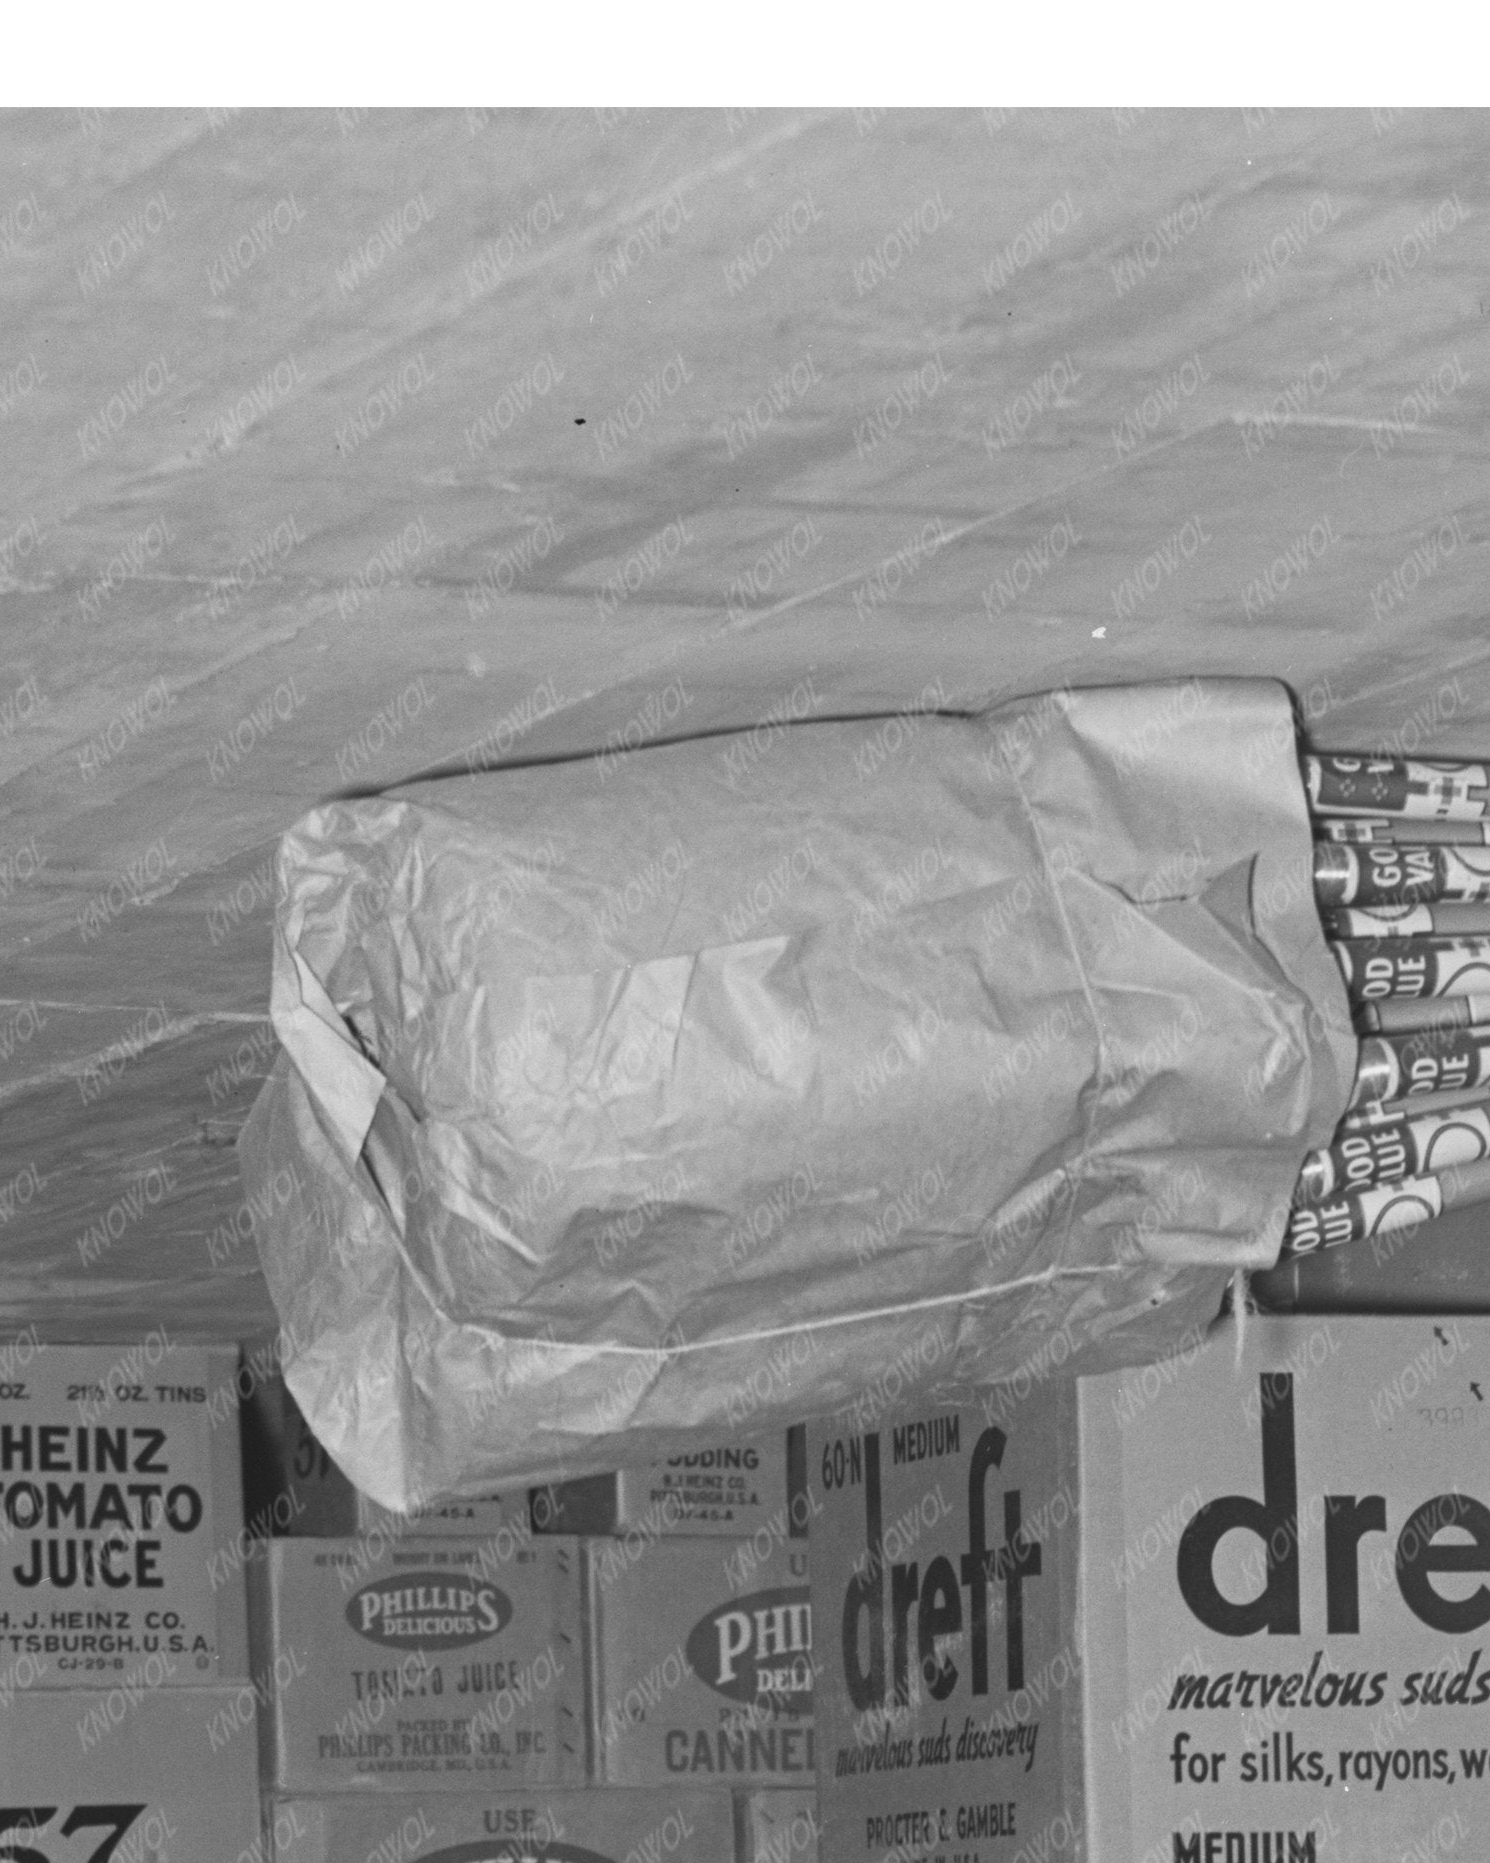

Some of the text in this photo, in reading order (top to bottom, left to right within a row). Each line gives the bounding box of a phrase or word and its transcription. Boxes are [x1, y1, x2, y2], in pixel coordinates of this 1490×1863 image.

[1, 1425, 168, 1473] HEINZ
[893, 1415, 960, 1464] MEDIUM
[13, 1539, 163, 1588] JUICE
[841, 1429, 1043, 1712] dreft
[1168, 1653, 1387, 1710] marvelous
[1170, 1732, 1225, 1783] for
[1241, 1732, 1333, 1787] silks,
[1339, 1744, 1455, 1791] rayons,
[484, 1809, 535, 1833] USE
[865, 1804, 1017, 1850] PROCTER & GAMBLE
